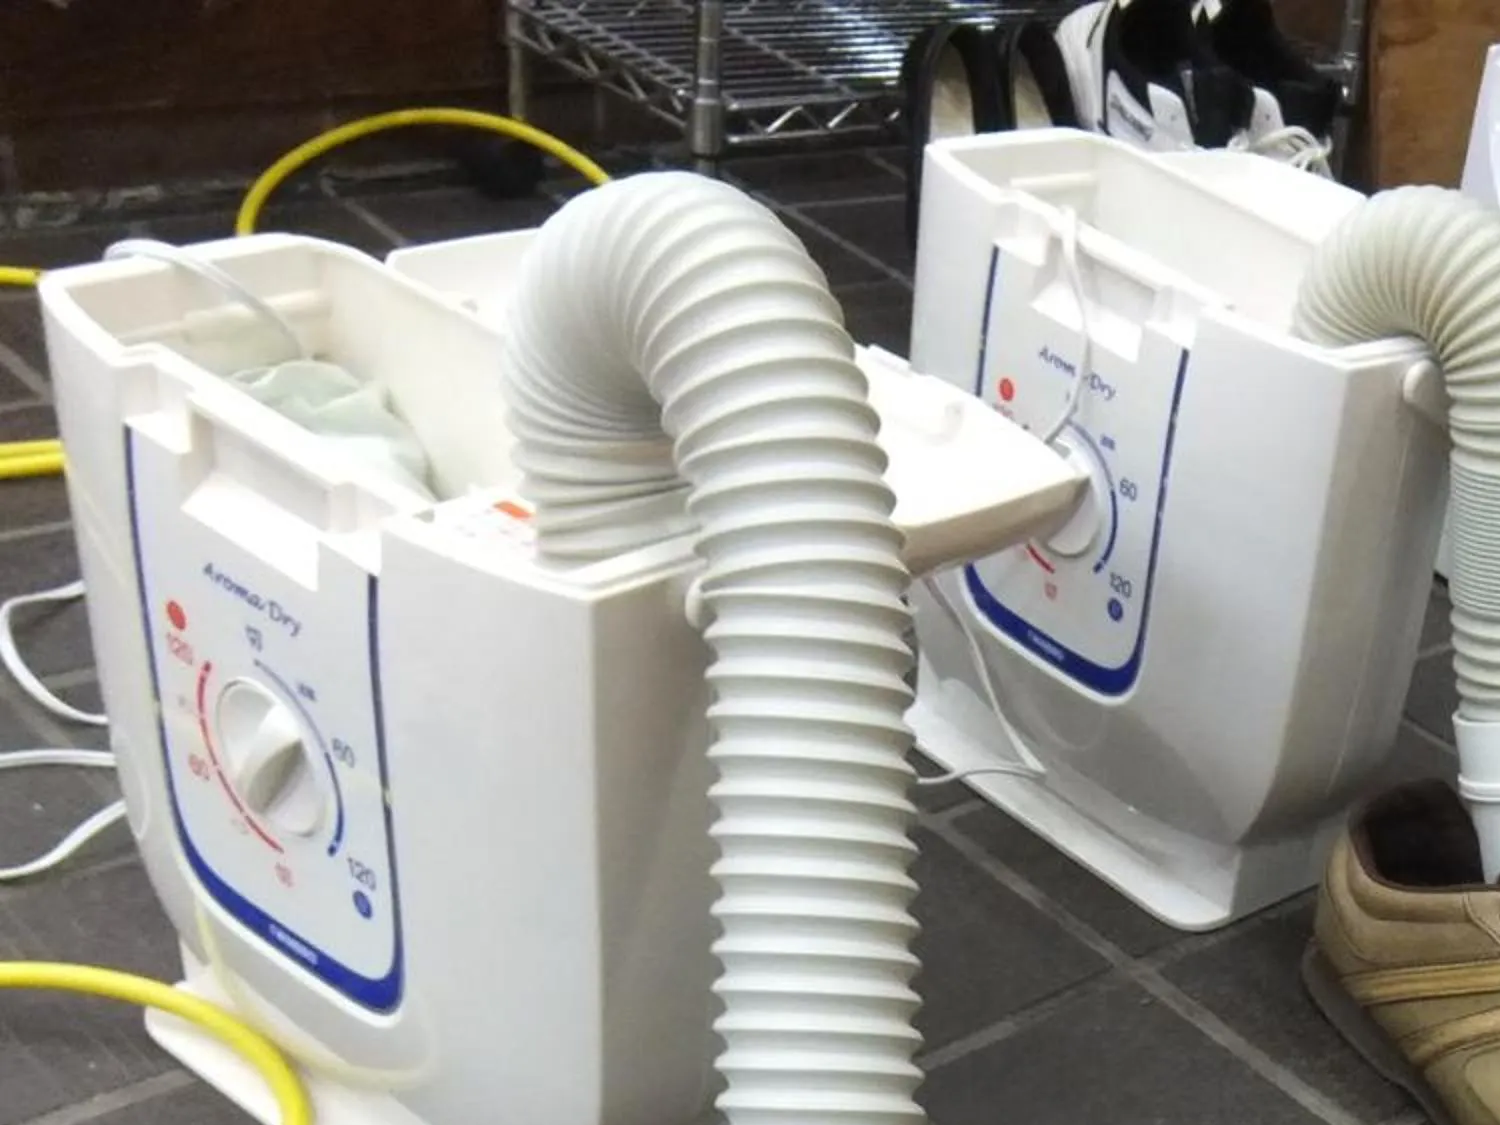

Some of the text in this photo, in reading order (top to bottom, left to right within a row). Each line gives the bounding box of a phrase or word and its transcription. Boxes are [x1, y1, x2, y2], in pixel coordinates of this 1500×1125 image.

[1119, 478, 1137, 501] 60
[1110, 572, 1133, 598] 120
[347, 857, 377, 891] 120
